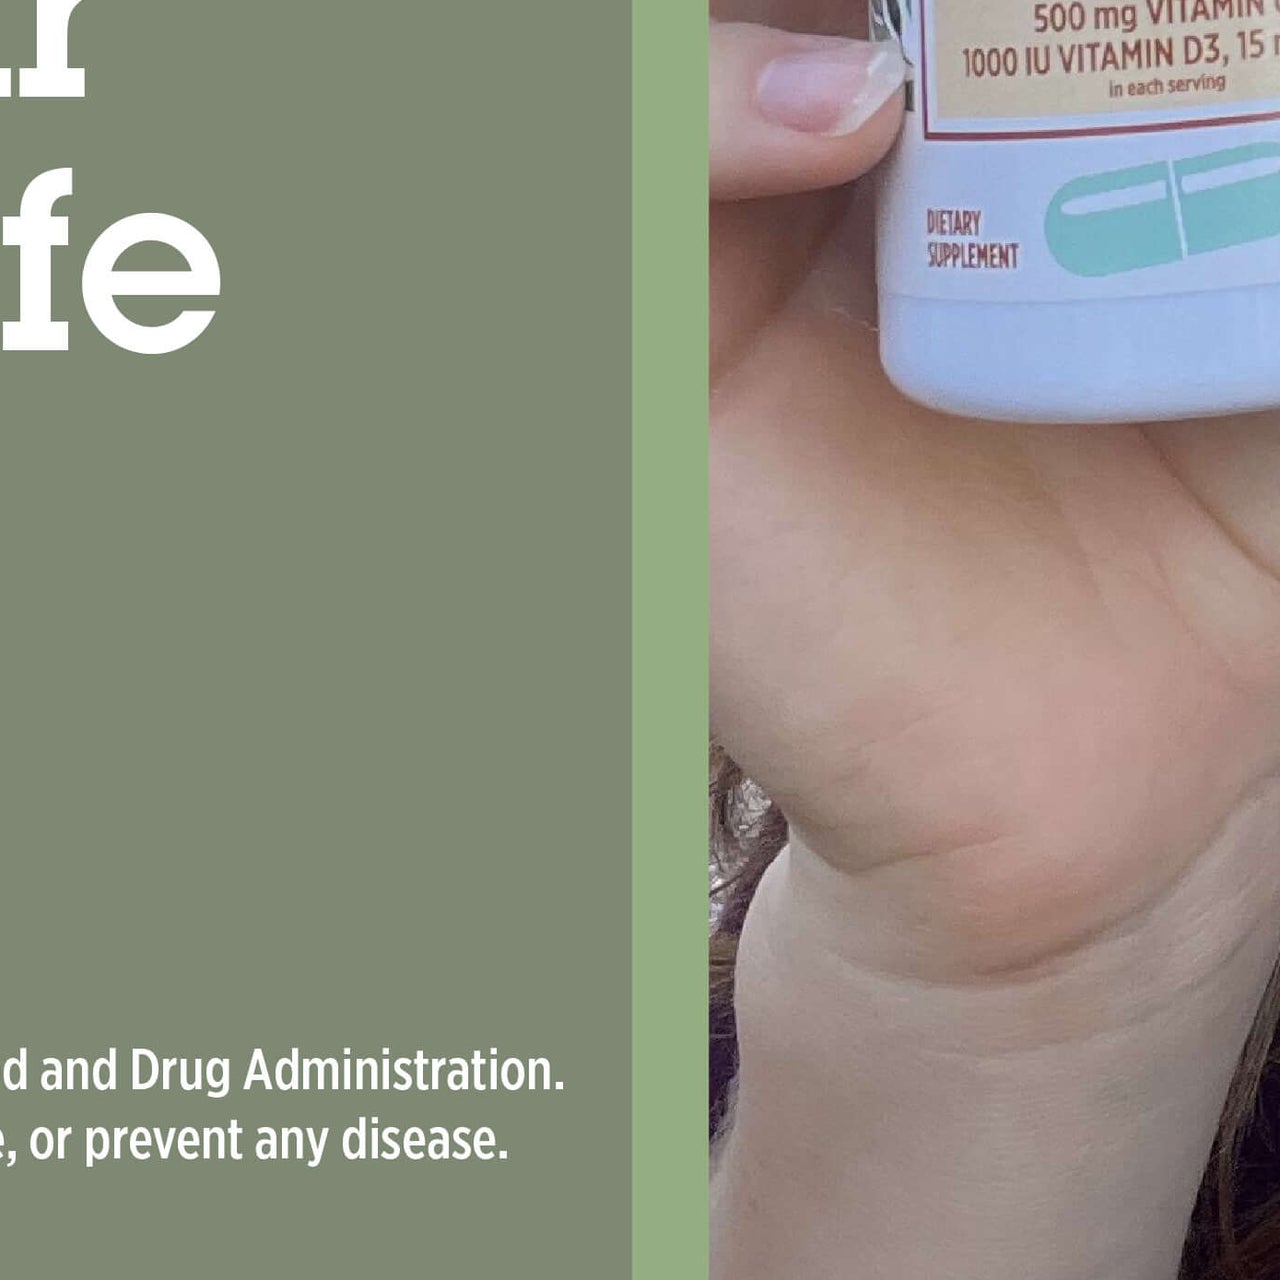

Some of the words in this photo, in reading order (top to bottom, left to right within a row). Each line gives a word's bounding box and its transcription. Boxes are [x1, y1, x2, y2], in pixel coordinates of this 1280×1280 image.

[1034, 2, 1085, 32] 500
[1094, 4, 1137, 32] mg
[963, 47, 1018, 77] 1000
[1026, 46, 1050, 76] IU
[1058, 37, 1173, 73] VITAMIN
[1184, 33, 1229, 67] D3,
[1238, 29, 1264, 59] 15
[1109, 80, 1123, 97] in
[1127, 78, 1164, 96] each
[1168, 73, 1226, 92] serving
[927, 209, 981, 236] DIETARY
[927, 242, 1019, 269] SUPPLEMENT
